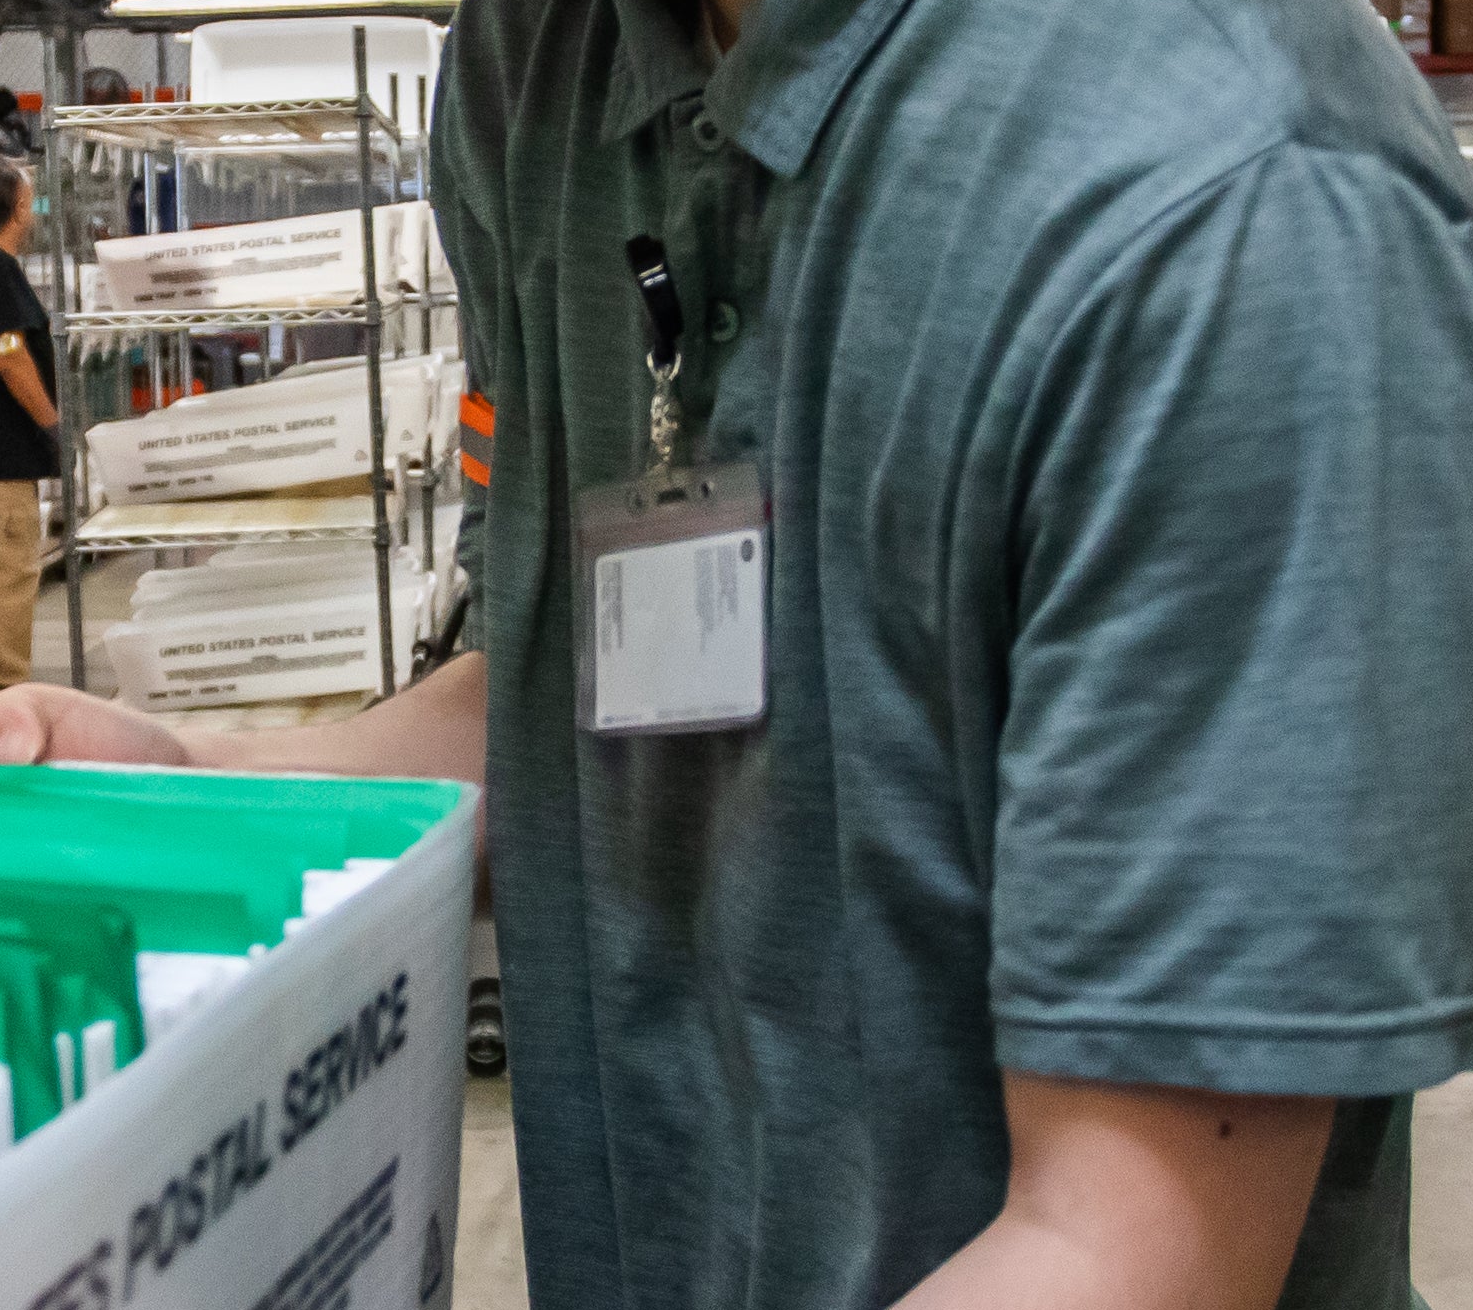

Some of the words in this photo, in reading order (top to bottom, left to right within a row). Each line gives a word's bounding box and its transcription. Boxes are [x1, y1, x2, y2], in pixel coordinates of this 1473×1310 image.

[192, 242, 235, 255] STATES
[238, 235, 285, 249] POSTAL
[290, 228, 342, 243] SERVICE
[138, 436, 182, 451] UNITED
[186, 430, 230, 444] STATES
[234, 424, 280, 438] POSTAL
[284, 415, 336, 432] SERVICE
[312, 626, 366, 642] SERVICE
[122, 1099, 274, 1303] POSTAL
[280, 969, 408, 1153] SERVICE
